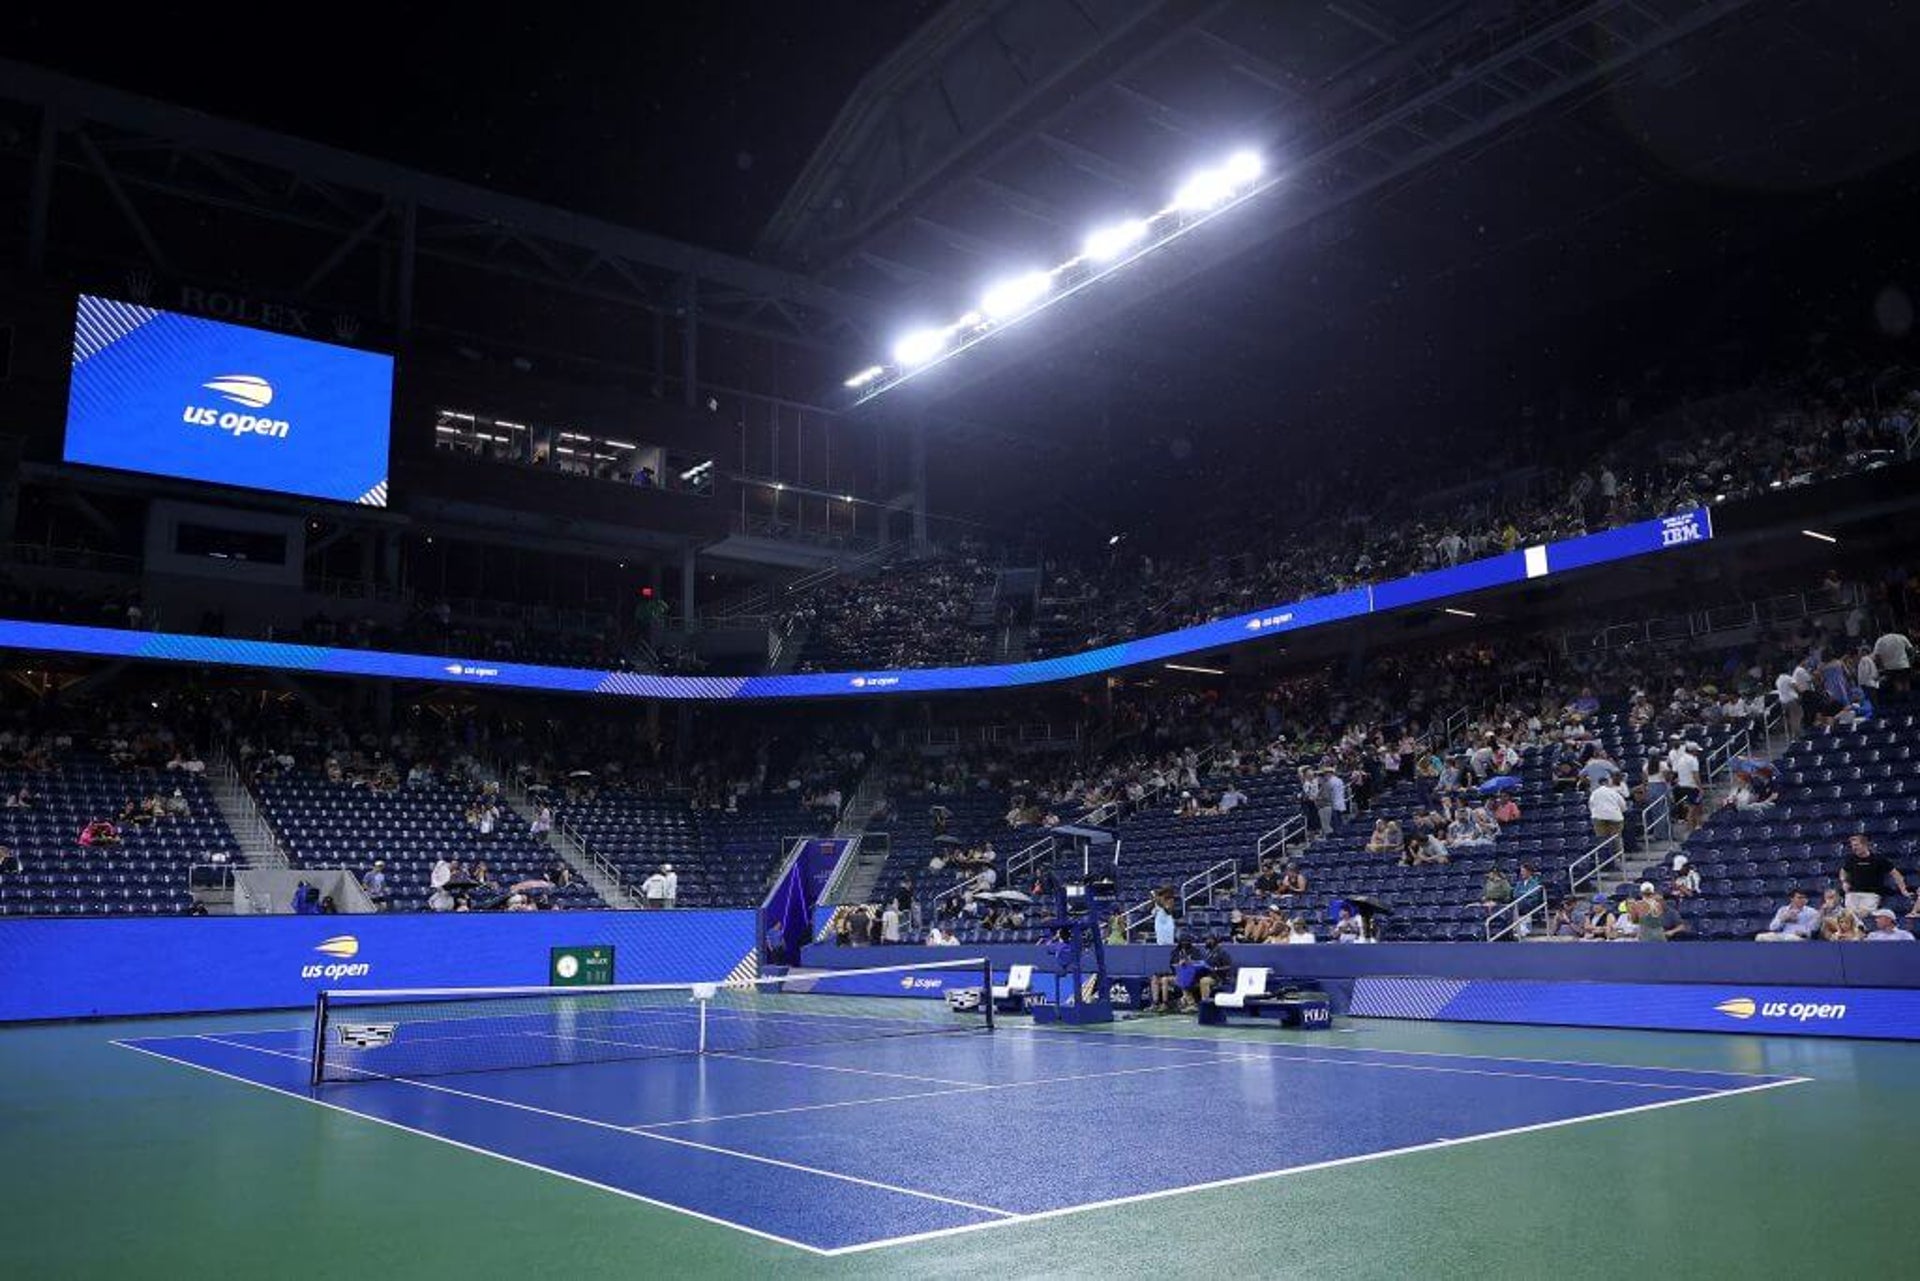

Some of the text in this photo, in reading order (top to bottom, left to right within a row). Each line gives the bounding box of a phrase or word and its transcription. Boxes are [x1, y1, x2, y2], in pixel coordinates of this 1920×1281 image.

[181, 286, 311, 332] ROLEX
[183, 405, 290, 438] us open
[1662, 522, 1702, 546] IBM
[301, 963, 369, 981] us open
[1303, 1008, 1329, 1023] POLO
[1761, 1002, 1847, 1021] us open
